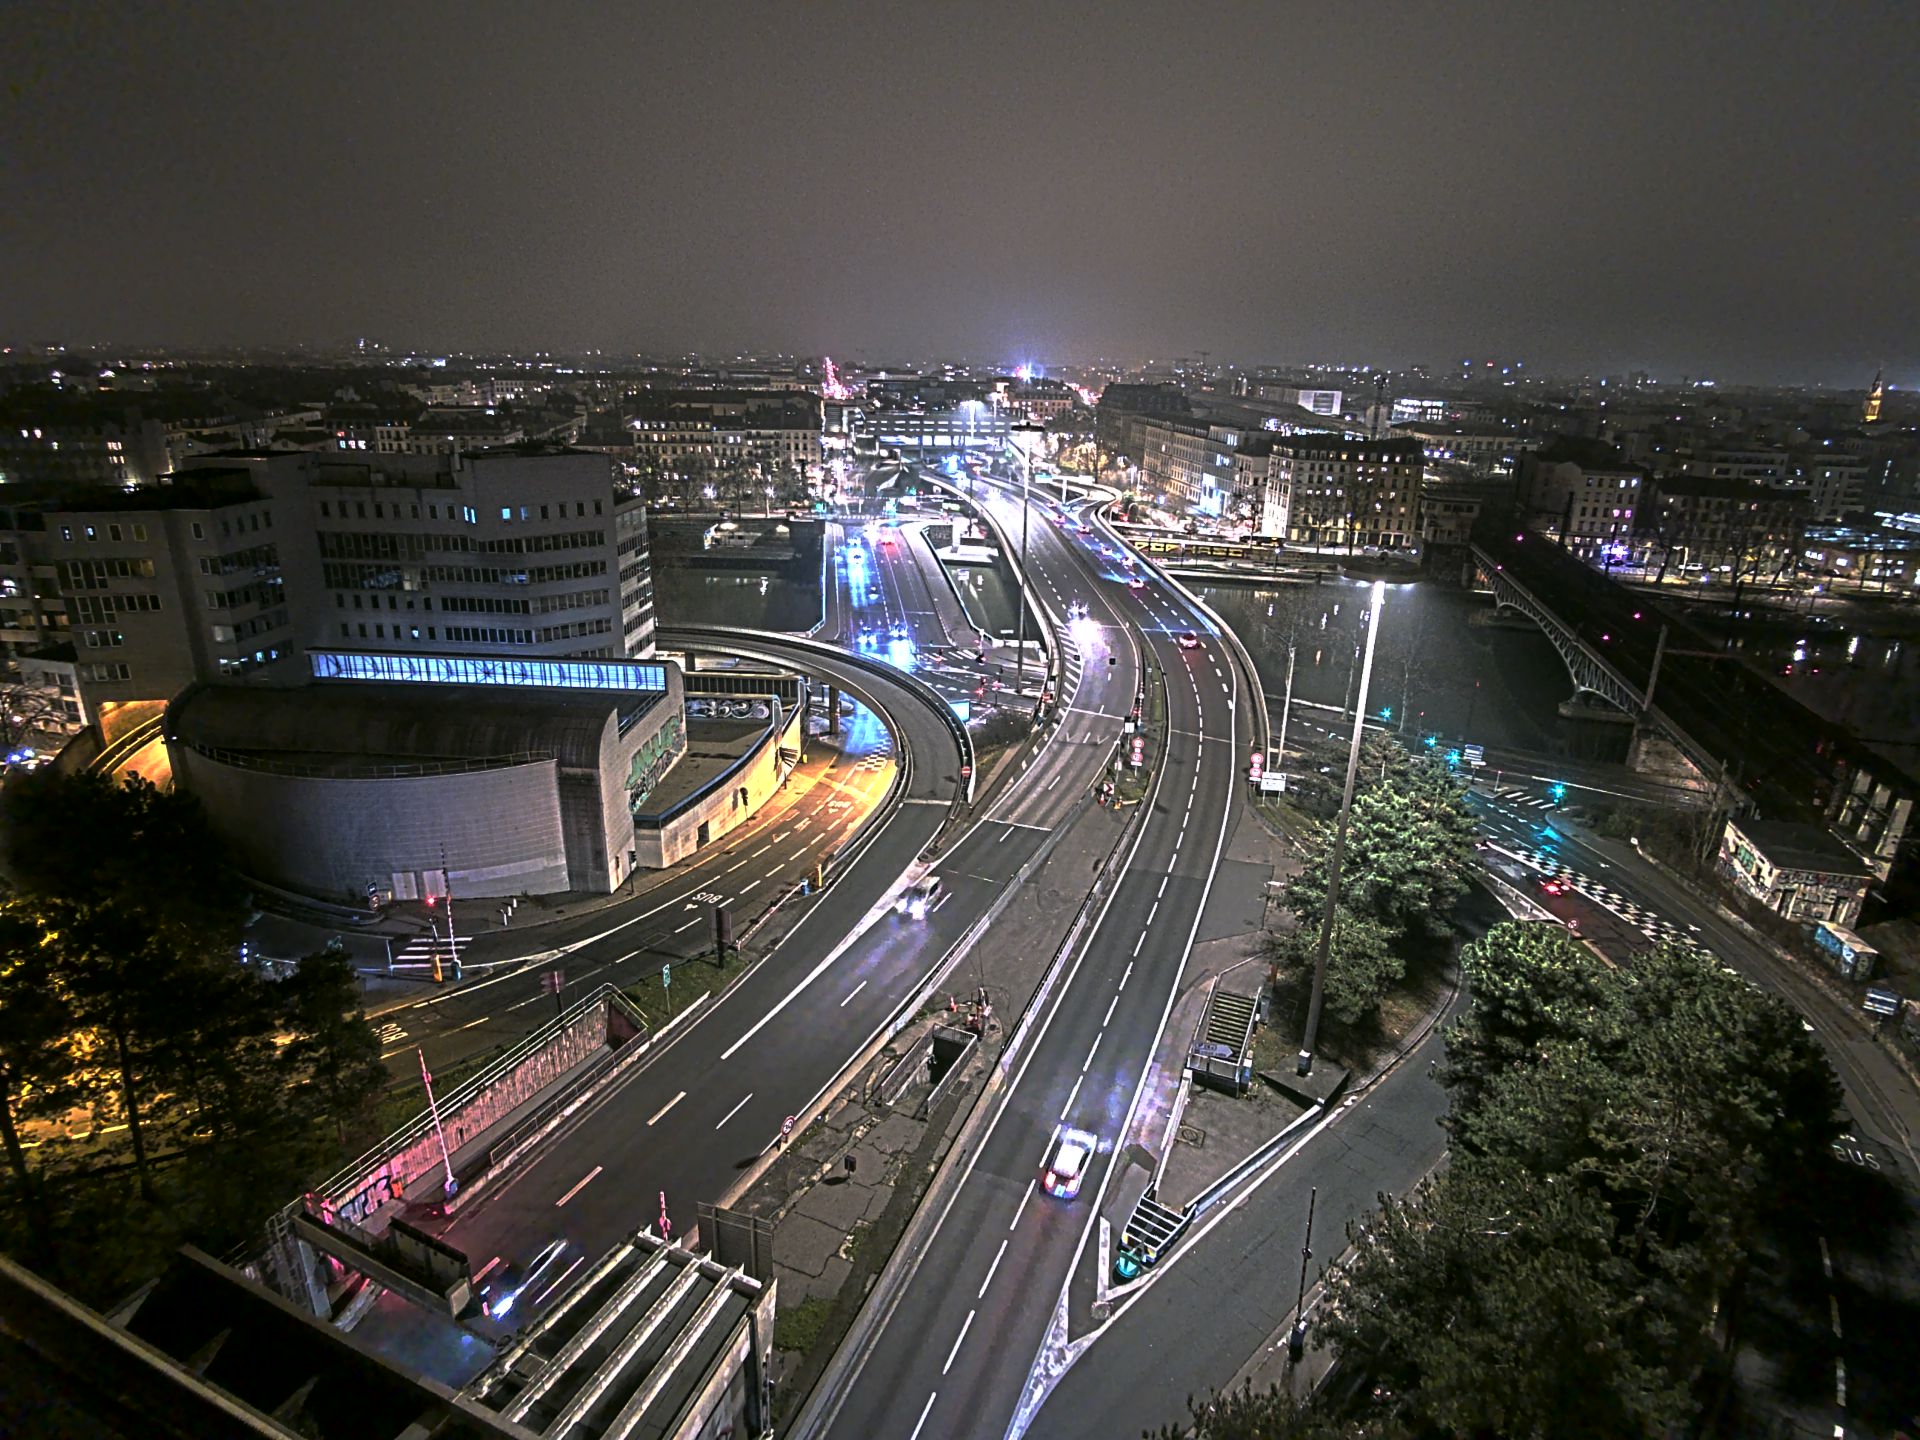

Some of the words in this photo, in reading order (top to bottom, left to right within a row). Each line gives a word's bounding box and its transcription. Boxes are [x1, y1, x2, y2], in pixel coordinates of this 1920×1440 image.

[692, 892, 723, 904] BUS
[381, 1023, 409, 1045] BUS
[1831, 1144, 1880, 1170] BUS
